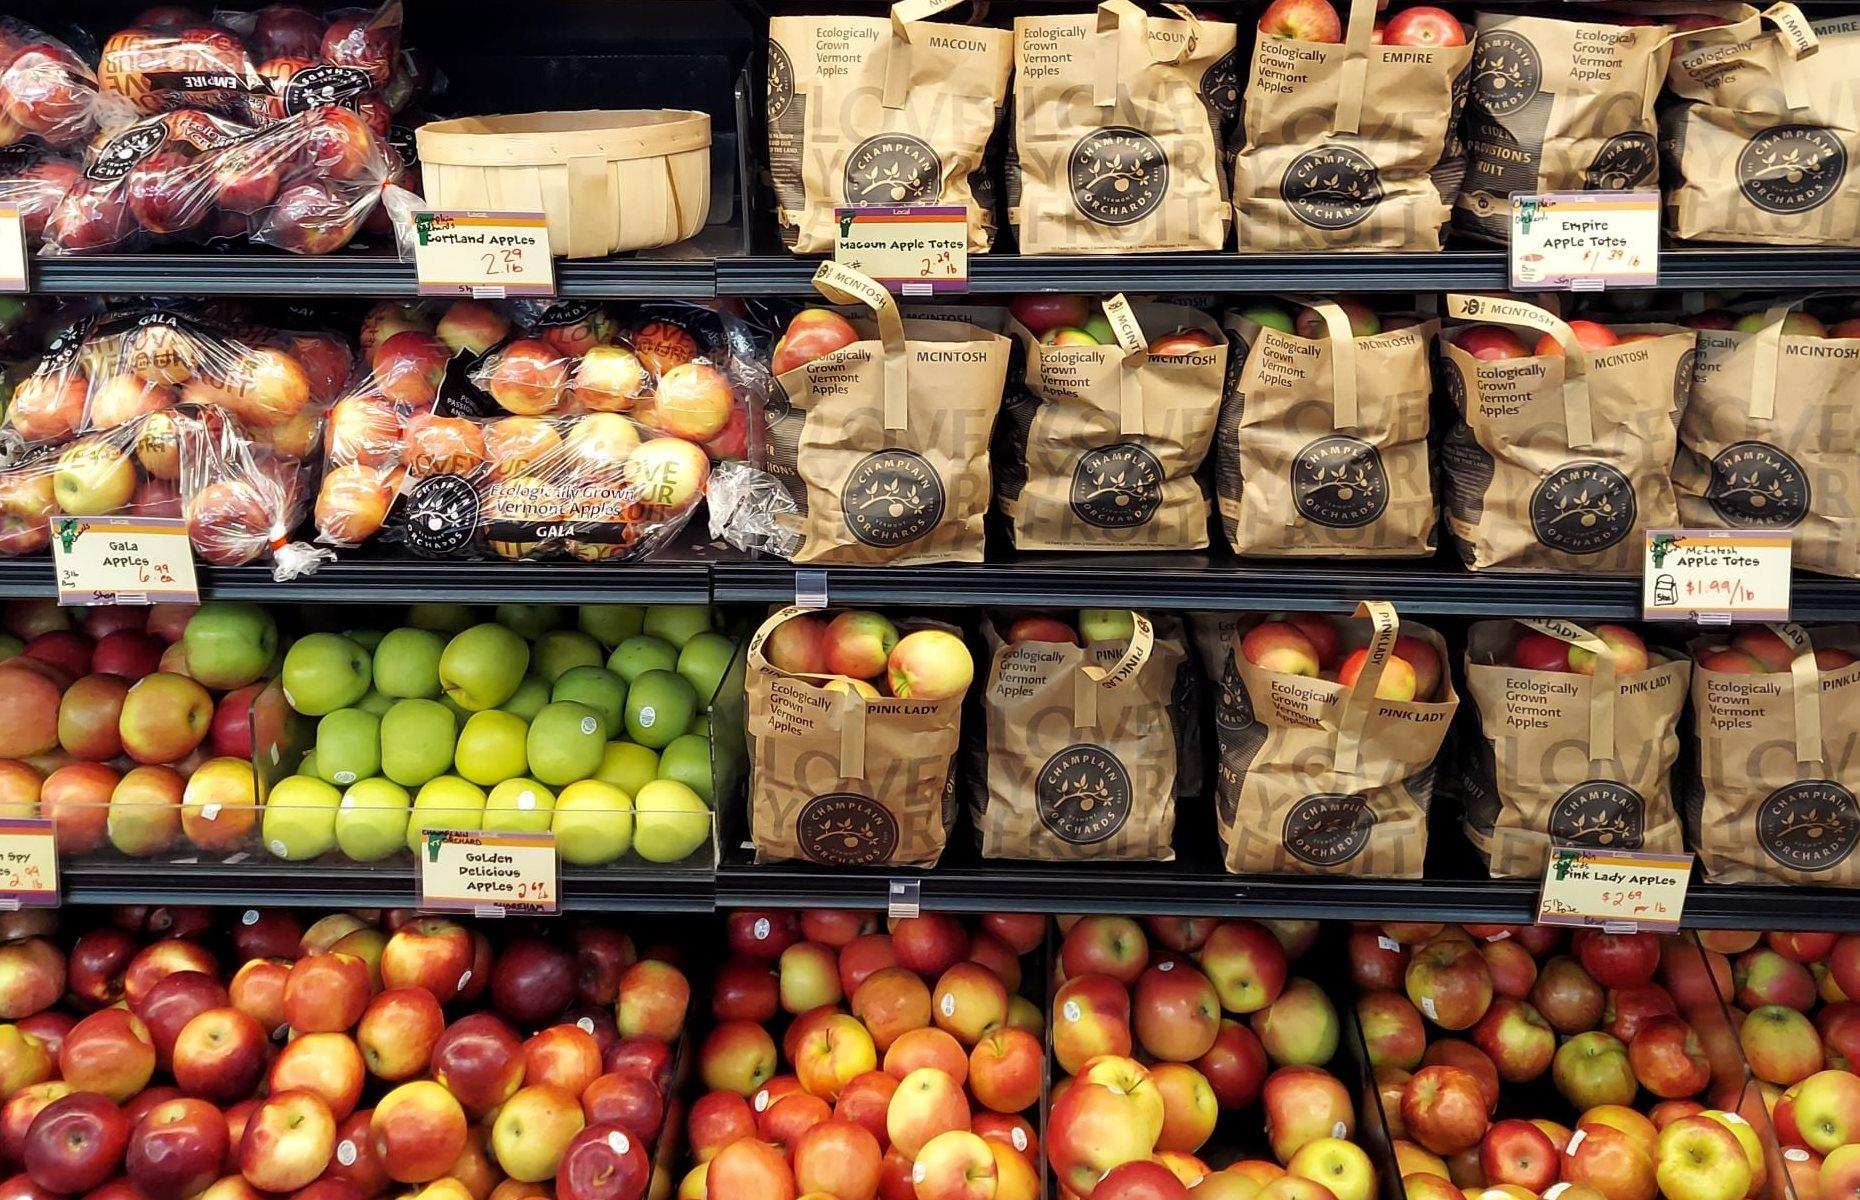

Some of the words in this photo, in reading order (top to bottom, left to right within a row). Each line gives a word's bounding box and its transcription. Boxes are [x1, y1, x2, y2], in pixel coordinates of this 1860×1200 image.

[816, 28, 879, 41] Ecologically
[1024, 27, 1087, 40] Ecologically
[1781, 15, 1810, 50] EMPIR
[1814, 21, 1859, 37] MPIRE
[816, 41, 849, 50] Grown
[930, 36, 987, 52] MACOUN
[1023, 41, 1058, 50] Grown
[1573, 42, 1614, 55] Grown
[816, 53, 862, 63] Vermont
[1023, 53, 1072, 63] Vermont
[1261, 41, 1327, 64] Ecologically
[1382, 52, 1433, 64] EMPIRE
[1476, 38, 1532, 66] HAMPLAIN
[1682, 42, 1752, 69] Ecologically
[1260, 54, 1295, 70] Grown
[1572, 54, 1622, 68] Vermont
[816, 66, 849, 77] Apples
[1023, 66, 1060, 78] Apples
[1258, 66, 1308, 83] Vermont
[1570, 67, 1612, 81] Apples
[184, 76, 237, 89] EMPIRE
[1257, 79, 1294, 94] Apples
[1080, 136, 1154, 165] CHAMPLAIN
[1755, 131, 1835, 156] CHAMPLAIN
[857, 143, 932, 172] CHAMPLAIN
[1751, 181, 1824, 204] ORCHARDS
[1084, 190, 1153, 215] ORCHARDS
[1298, 198, 1362, 220] ORCHARD
[1561, 218, 1609, 232] Empire
[426, 233, 485, 244] Cortland
[489, 235, 536, 246] Apples
[840, 240, 886, 250] Macoun
[889, 238, 925, 251] Apple
[928, 240, 964, 249] Totes
[1543, 237, 1584, 249] Apple
[1589, 236, 1627, 247] Totes
[834, 272, 887, 309] MCINTOSH
[138, 313, 177, 327] GALA
[1490, 304, 1555, 328] MCINTOSH
[1265, 333, 1322, 359] Ecologically
[1358, 335, 1416, 351] MCINTOSH
[916, 351, 988, 363] MCINTOSH
[1040, 351, 1105, 365] Ecologically
[1263, 346, 1294, 364] Grown
[1786, 344, 1859, 359] MCINTOSH
[1148, 354, 1217, 366] MCINTOSH
[1594, 350, 1649, 370] MCINTOSH
[806, 363, 846, 373] Grown
[1040, 365, 1077, 375] Grown
[1261, 359, 1306, 379] Vermont
[1476, 364, 1547, 379] Ecologically
[808, 373, 860, 384] Vermont
[1040, 377, 1090, 387] Vermont
[1257, 371, 1292, 388] Apples
[1477, 380, 1516, 391] Grown
[812, 384, 849, 395] Apples
[1042, 386, 1079, 398] Apples
[1478, 391, 1533, 403] Vermont
[1479, 404, 1520, 418] Apples
[859, 459, 932, 489] CHAMPLAIN
[1086, 452, 1156, 483] CHAMPLAIN
[1719, 453, 1796, 483] CHAMPLAIN
[1546, 470, 1621, 500] CHAMPLAIN
[582, 486, 635, 500] Grown
[495, 500, 564, 515] Vermont
[569, 502, 621, 517] Apples
[1305, 498, 1376, 520] ORCHARDS
[536, 525, 576, 538] GALA
[856, 514, 926, 539] ORCHARDS
[1547, 524, 1619, 547] ORCHARDS
[109, 541, 139, 551] Gala
[103, 556, 149, 567] Apples
[1677, 556, 1718, 571] Apple
[1722, 557, 1760, 567] Totes
[1378, 612, 1397, 643] PINK
[1371, 640, 1390, 666] LADY
[1000, 660, 1037, 673] Grown
[999, 672, 1048, 685] Vermont
[1620, 681, 1649, 695] PINK
[1649, 675, 1672, 690] LADY
[1822, 676, 1853, 691] PINK
[997, 684, 1034, 697] Apples
[1271, 680, 1339, 706] Ecologically
[1506, 678, 1579, 697] Ecologically
[1707, 680, 1781, 696] Ecologically
[770, 693, 804, 714] Grown
[771, 681, 832, 711] Ecologically
[1271, 692, 1309, 712] Grown
[1505, 691, 1548, 704] Grown
[1707, 692, 1750, 706] Grown
[770, 704, 814, 729] Vermont
[868, 705, 901, 714] PINK
[904, 705, 939, 715] LADY
[1272, 703, 1321, 726] Vermont
[1378, 707, 1414, 719] PINK
[1414, 708, 1447, 723] LADY
[1506, 703, 1562, 717] Vermont
[1708, 704, 1766, 717] Vermont
[768, 715, 803, 736] Apples
[1506, 716, 1549, 729] Apples
[1710, 718, 1753, 731] Apples
[1048, 755, 1118, 785] CHAMPLAIN
[1772, 791, 1847, 816] CHAMPLAIN
[811, 802, 884, 826] CHAMPLAIN
[1050, 810, 1116, 834] ORCHARDS
[1296, 829, 1360, 858] ORCHARDS
[1774, 836, 1847, 861] ORCHARDS
[8, 852, 31, 863] Spy
[466, 853, 513, 864] Golden
[459, 866, 521, 878] Delicious
[1562, 870, 1590, 880] Pink
[1594, 872, 1627, 884] Lady
[1628, 875, 1677, 886] Apples
[466, 881, 514, 892] Apples
